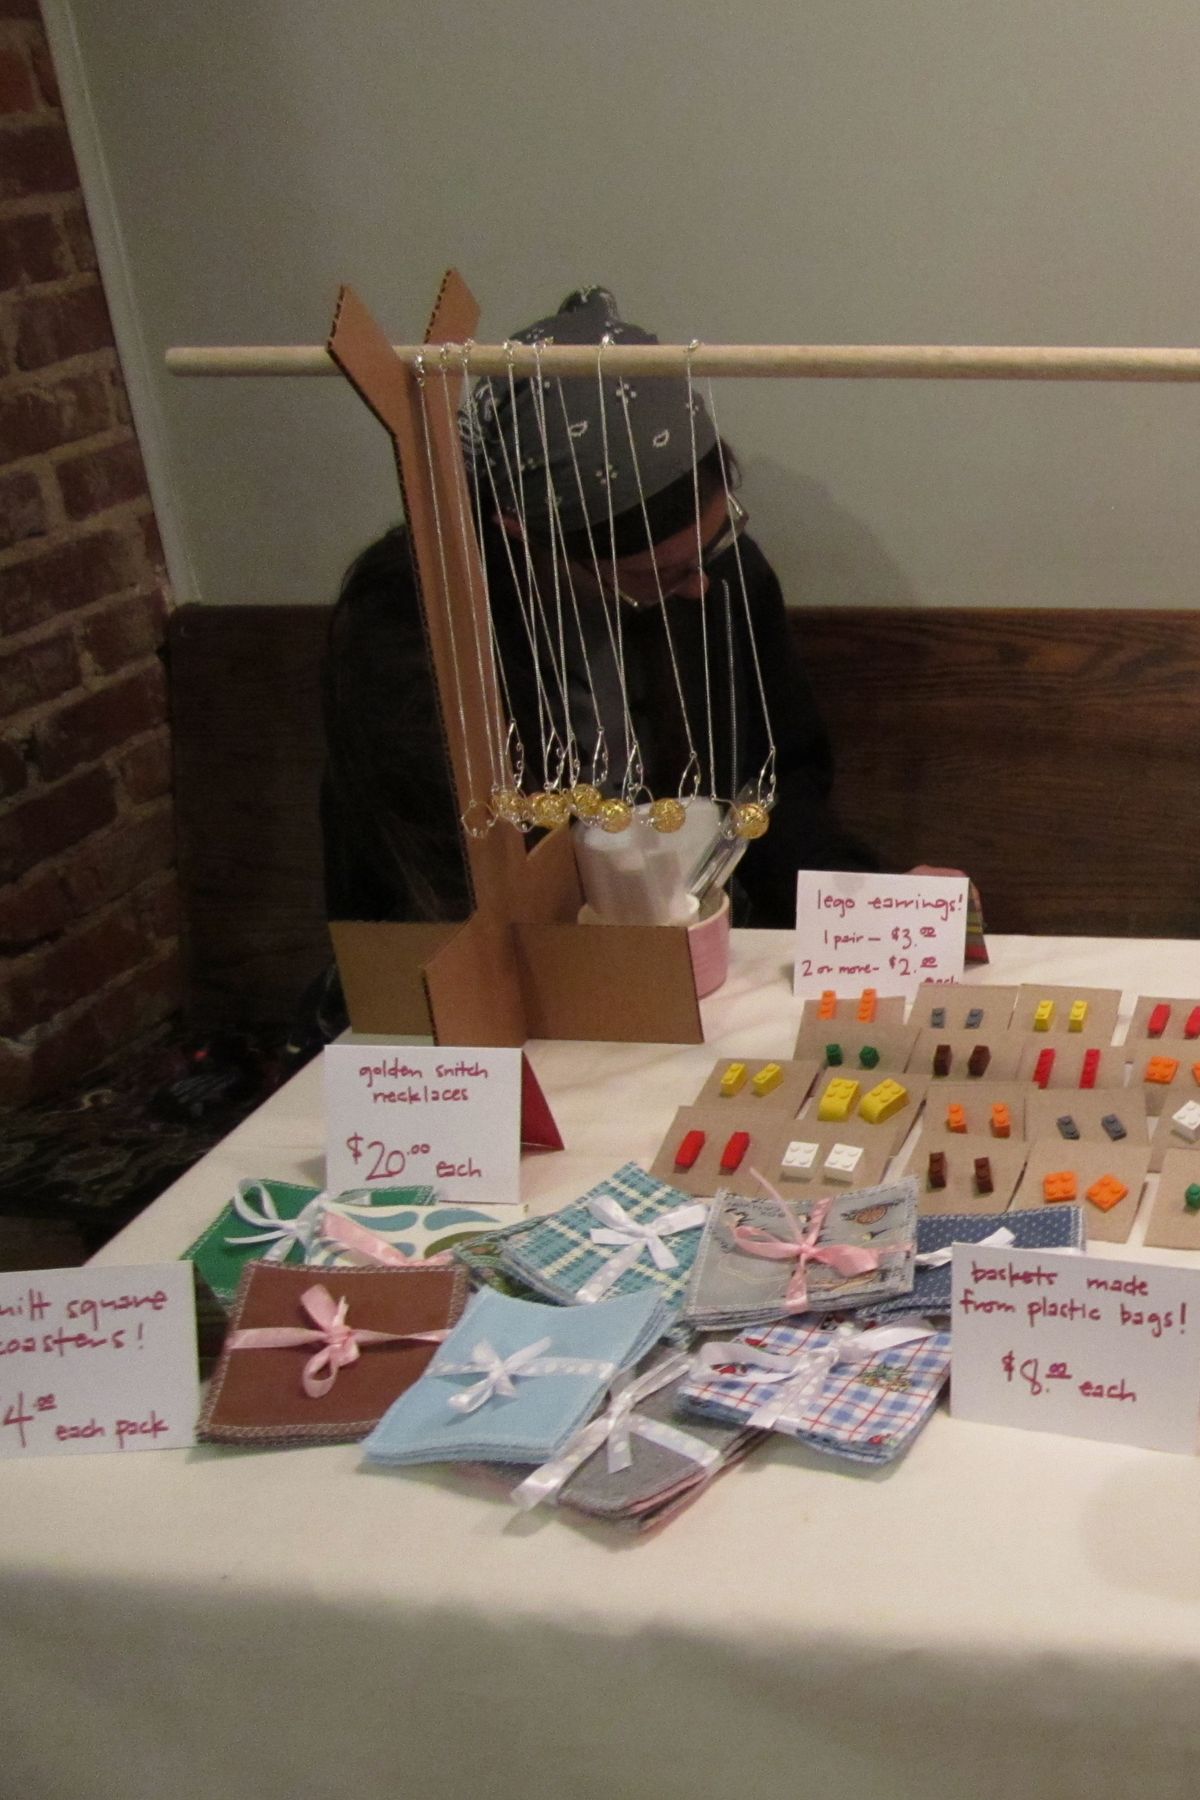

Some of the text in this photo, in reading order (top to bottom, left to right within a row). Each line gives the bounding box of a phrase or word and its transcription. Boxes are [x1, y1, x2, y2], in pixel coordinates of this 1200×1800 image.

[817, 889, 963, 921] lego earrings!
[802, 959, 813, 976] 2
[817, 965, 833, 974] or
[359, 1057, 488, 1088] golden snitch
[373, 1086, 468, 1104] necklaces
[436, 1158, 482, 1178] each
[971, 1261, 1149, 1296] baskets made
[67, 1290, 168, 1331] square
[960, 1289, 1187, 1337] from plastic bags!
[1079, 1379, 1136, 1402] each
[56, 1418, 104, 1441] each
[116, 1410, 169, 1449] pack
